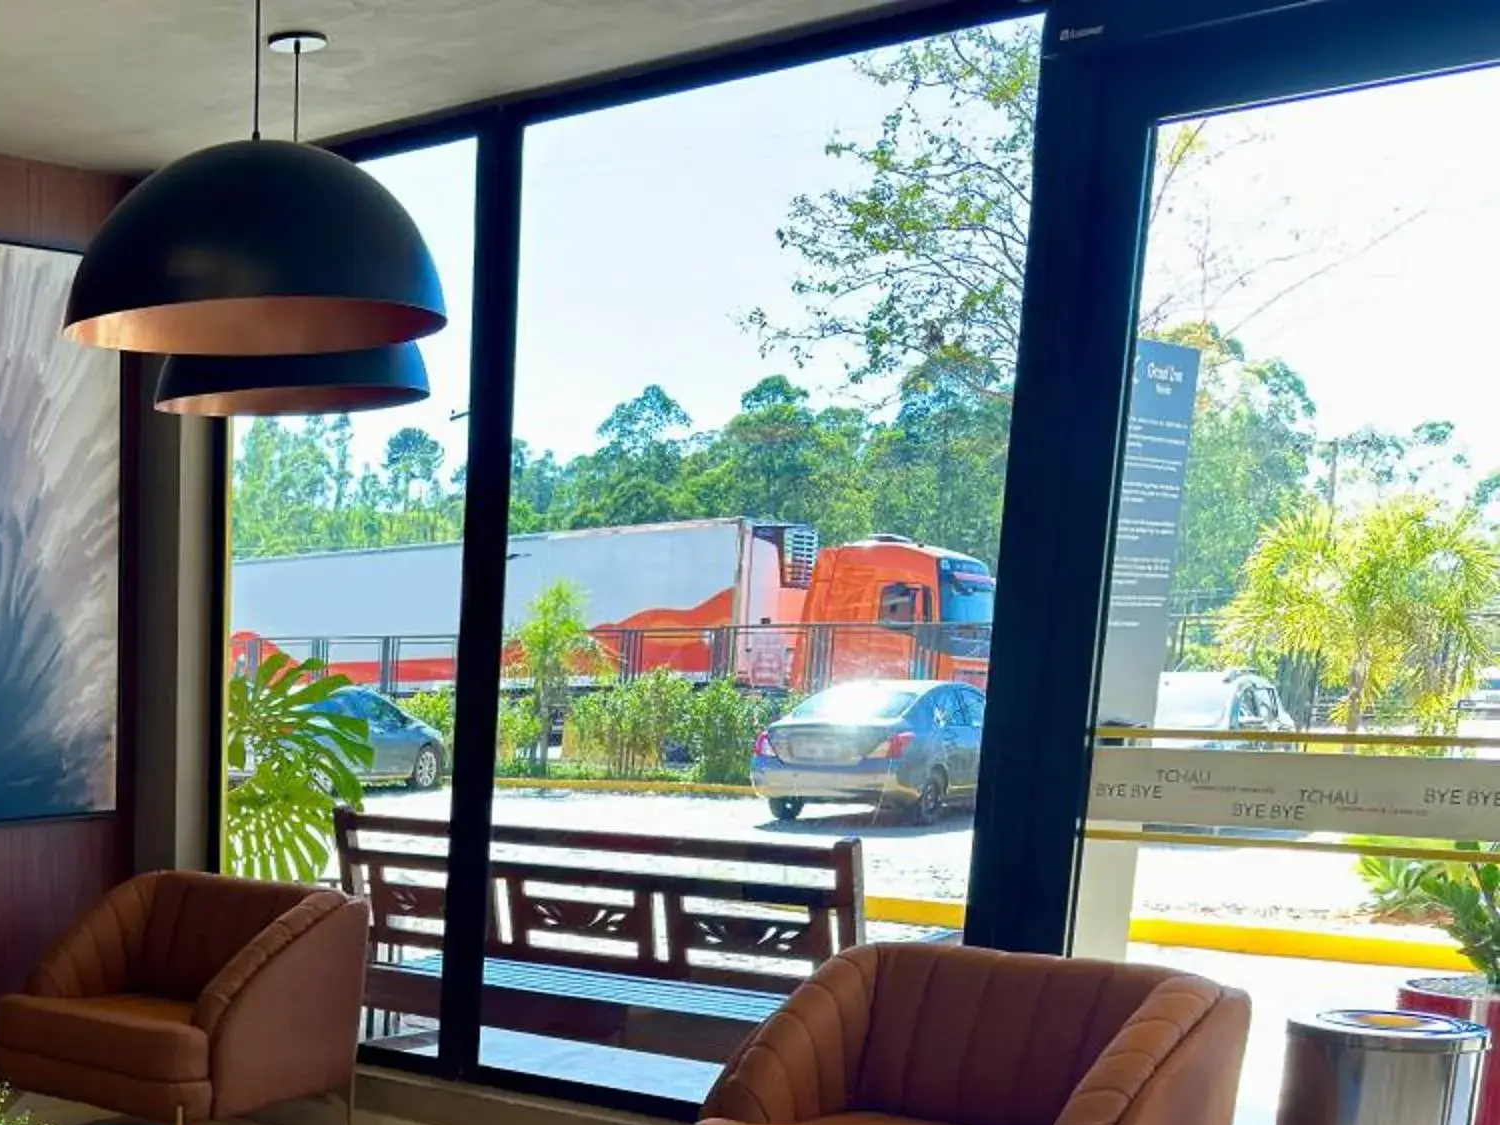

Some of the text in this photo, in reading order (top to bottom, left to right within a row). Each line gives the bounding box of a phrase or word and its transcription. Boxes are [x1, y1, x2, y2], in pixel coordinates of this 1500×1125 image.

[1157, 769, 1211, 784] TCHAU
[1095, 783, 1163, 799] BYE BYE
[1300, 788, 1359, 804] TCHAU
[1423, 788, 1462, 805] BYE
[1232, 803, 1305, 821] BYE BYE
